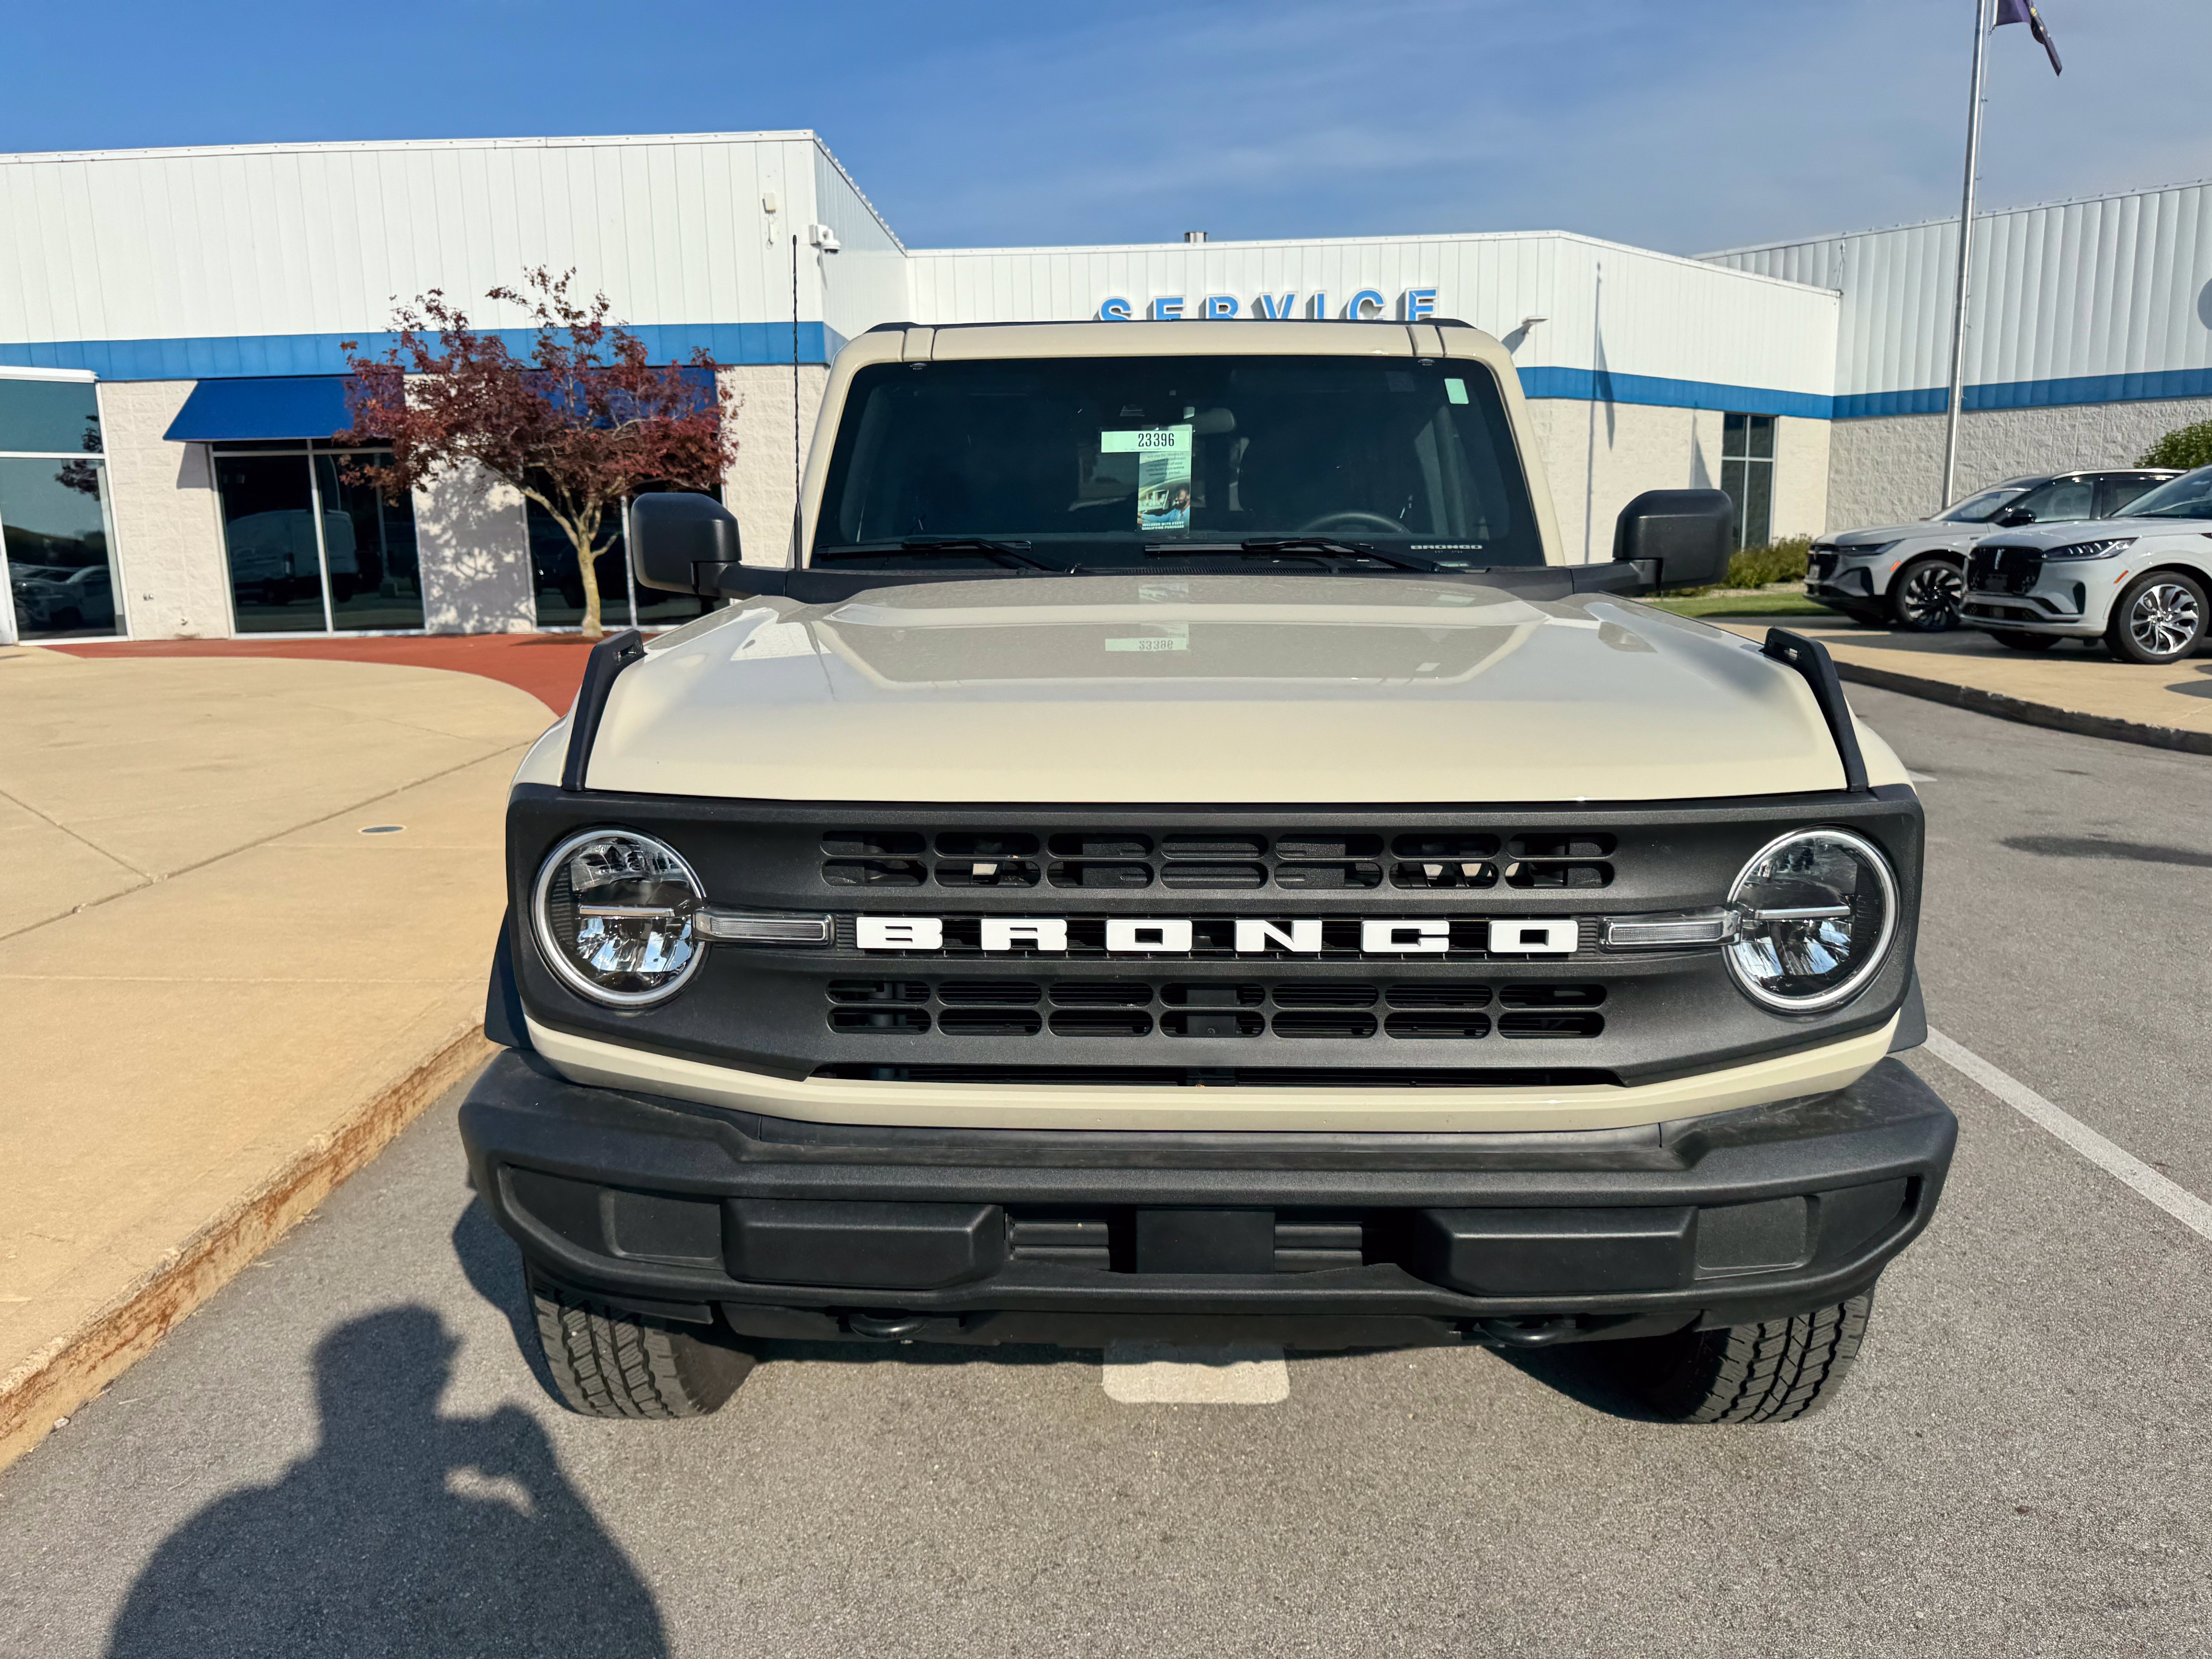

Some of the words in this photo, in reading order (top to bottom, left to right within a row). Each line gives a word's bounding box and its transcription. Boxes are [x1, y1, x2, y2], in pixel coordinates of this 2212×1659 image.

[1098, 287, 1438, 321] SERVICE
[1138, 433, 1175, 447] 23396
[856, 915, 1579, 953] BRONCO
